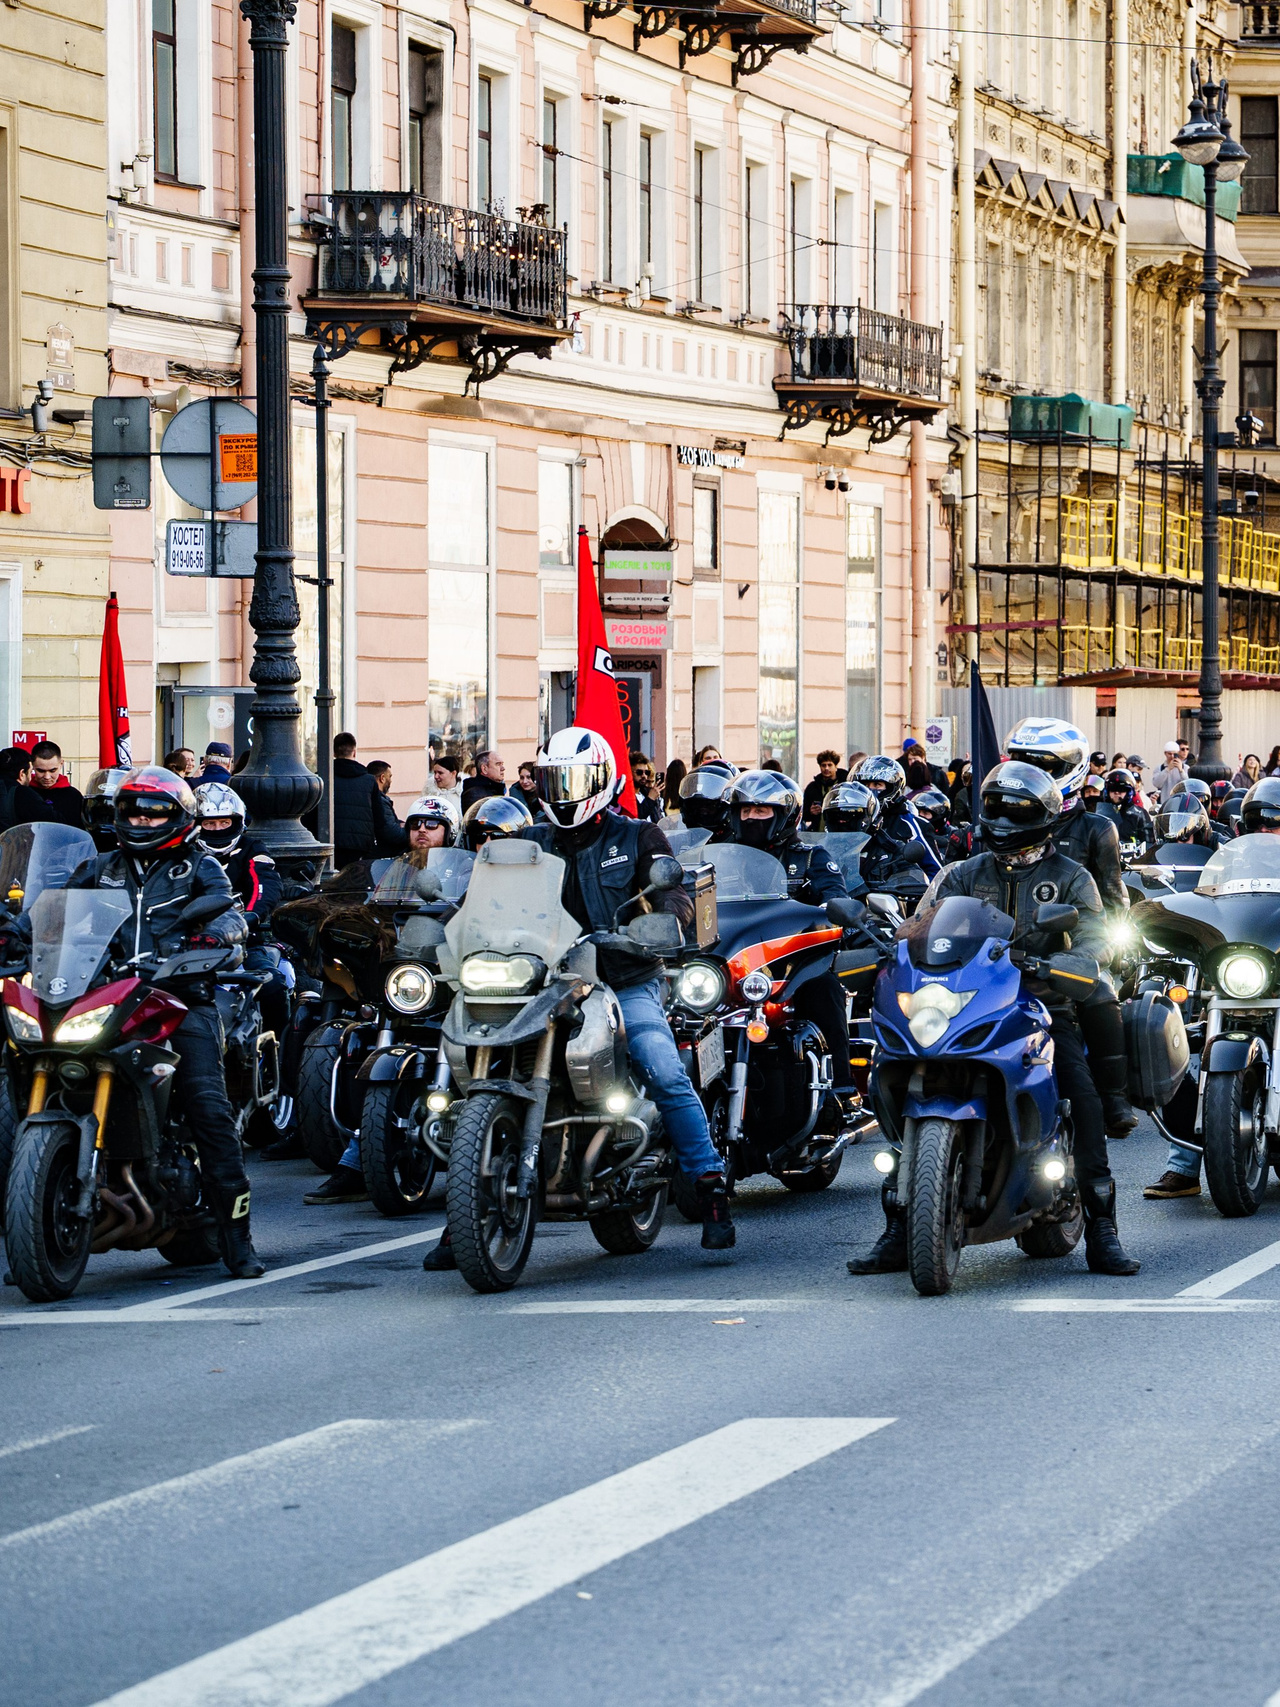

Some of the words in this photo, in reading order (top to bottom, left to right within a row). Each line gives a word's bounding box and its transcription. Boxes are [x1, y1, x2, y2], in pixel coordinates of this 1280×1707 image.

[698, 448, 714, 468] YOU
[172, 526, 204, 546] ХОСТЕЛ
[171, 550, 204, 568] 919-06-56
[605, 560, 640, 570] LINGERIE
[642, 561, 648, 570] &
[650, 561, 672, 571] TOYS
[611, 623, 667, 635] РОЗОВЫЙ
[615, 635, 662, 646] КРОЛИК
[611, 659, 658, 670] ARIPOSA
[1000, 780, 1021, 788] SHOEI
